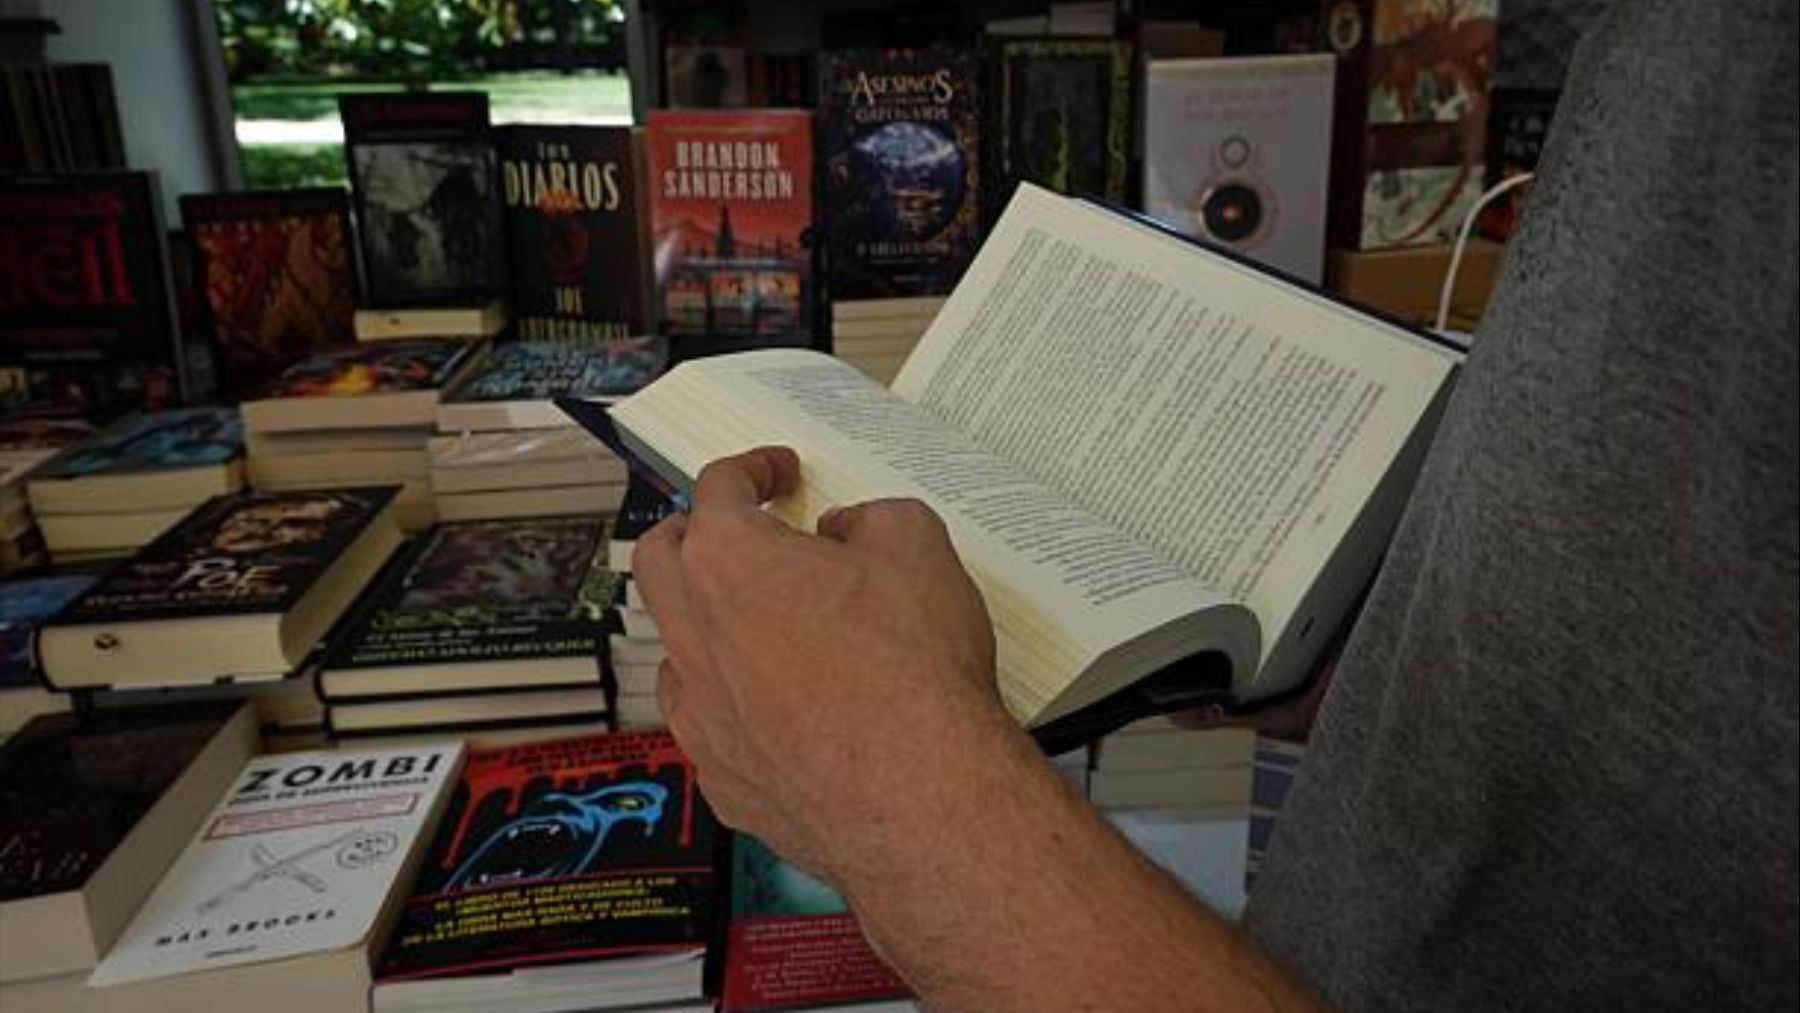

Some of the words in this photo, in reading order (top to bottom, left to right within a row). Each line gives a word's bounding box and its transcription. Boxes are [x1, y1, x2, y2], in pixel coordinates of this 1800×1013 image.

[676, 141, 780, 171] BRANDON
[502, 159, 621, 213] DIABLOS
[663, 169, 793, 200] SANDERSON
[239, 754, 442, 793] ZOMBI
